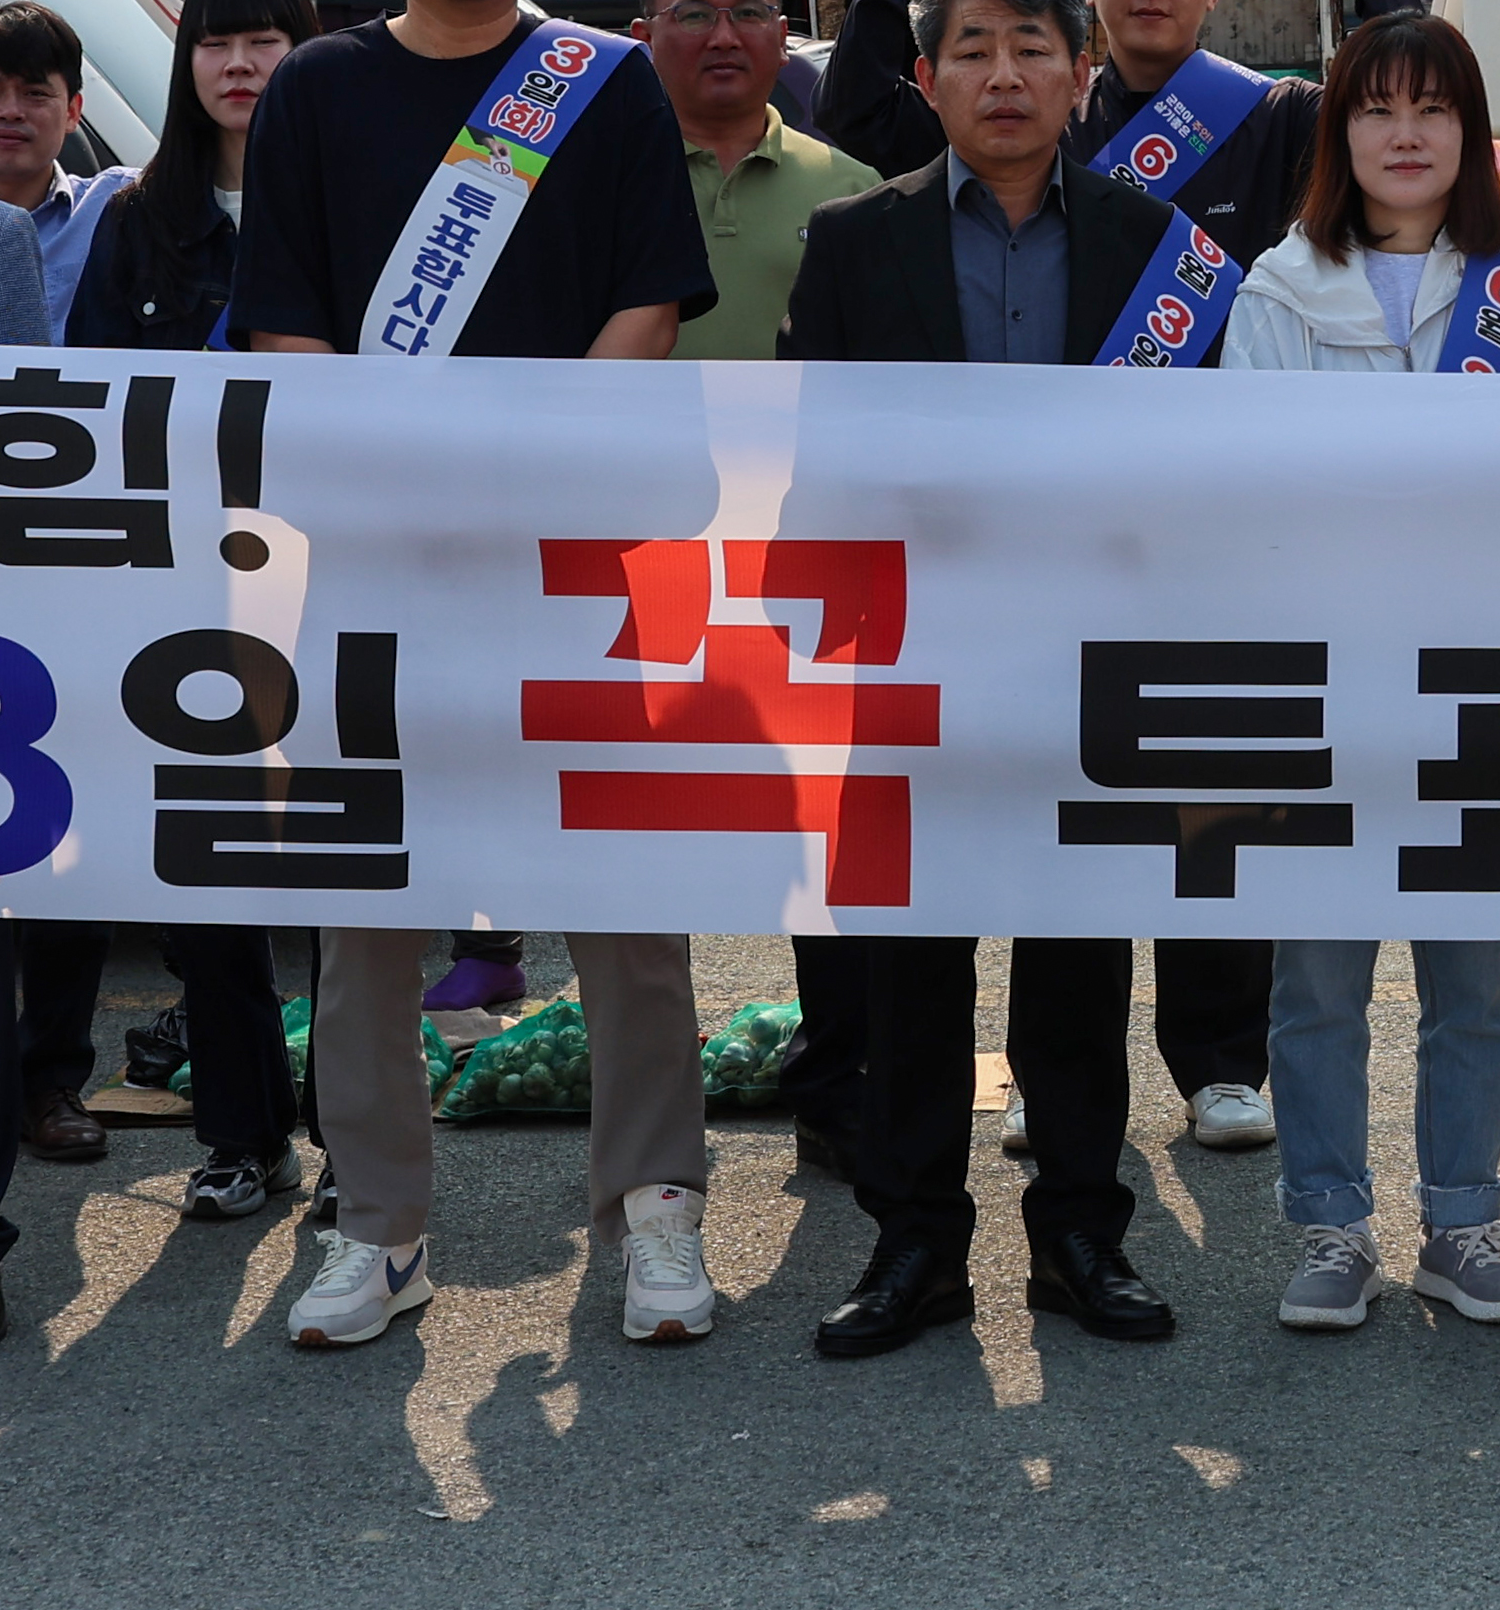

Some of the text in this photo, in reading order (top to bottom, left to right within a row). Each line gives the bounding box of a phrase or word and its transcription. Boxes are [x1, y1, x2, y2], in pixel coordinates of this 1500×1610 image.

[1165, 93, 1195, 123] 군민이
[380, 180, 498, 356] 투표합시다
[520, 537, 941, 907] 꼭
